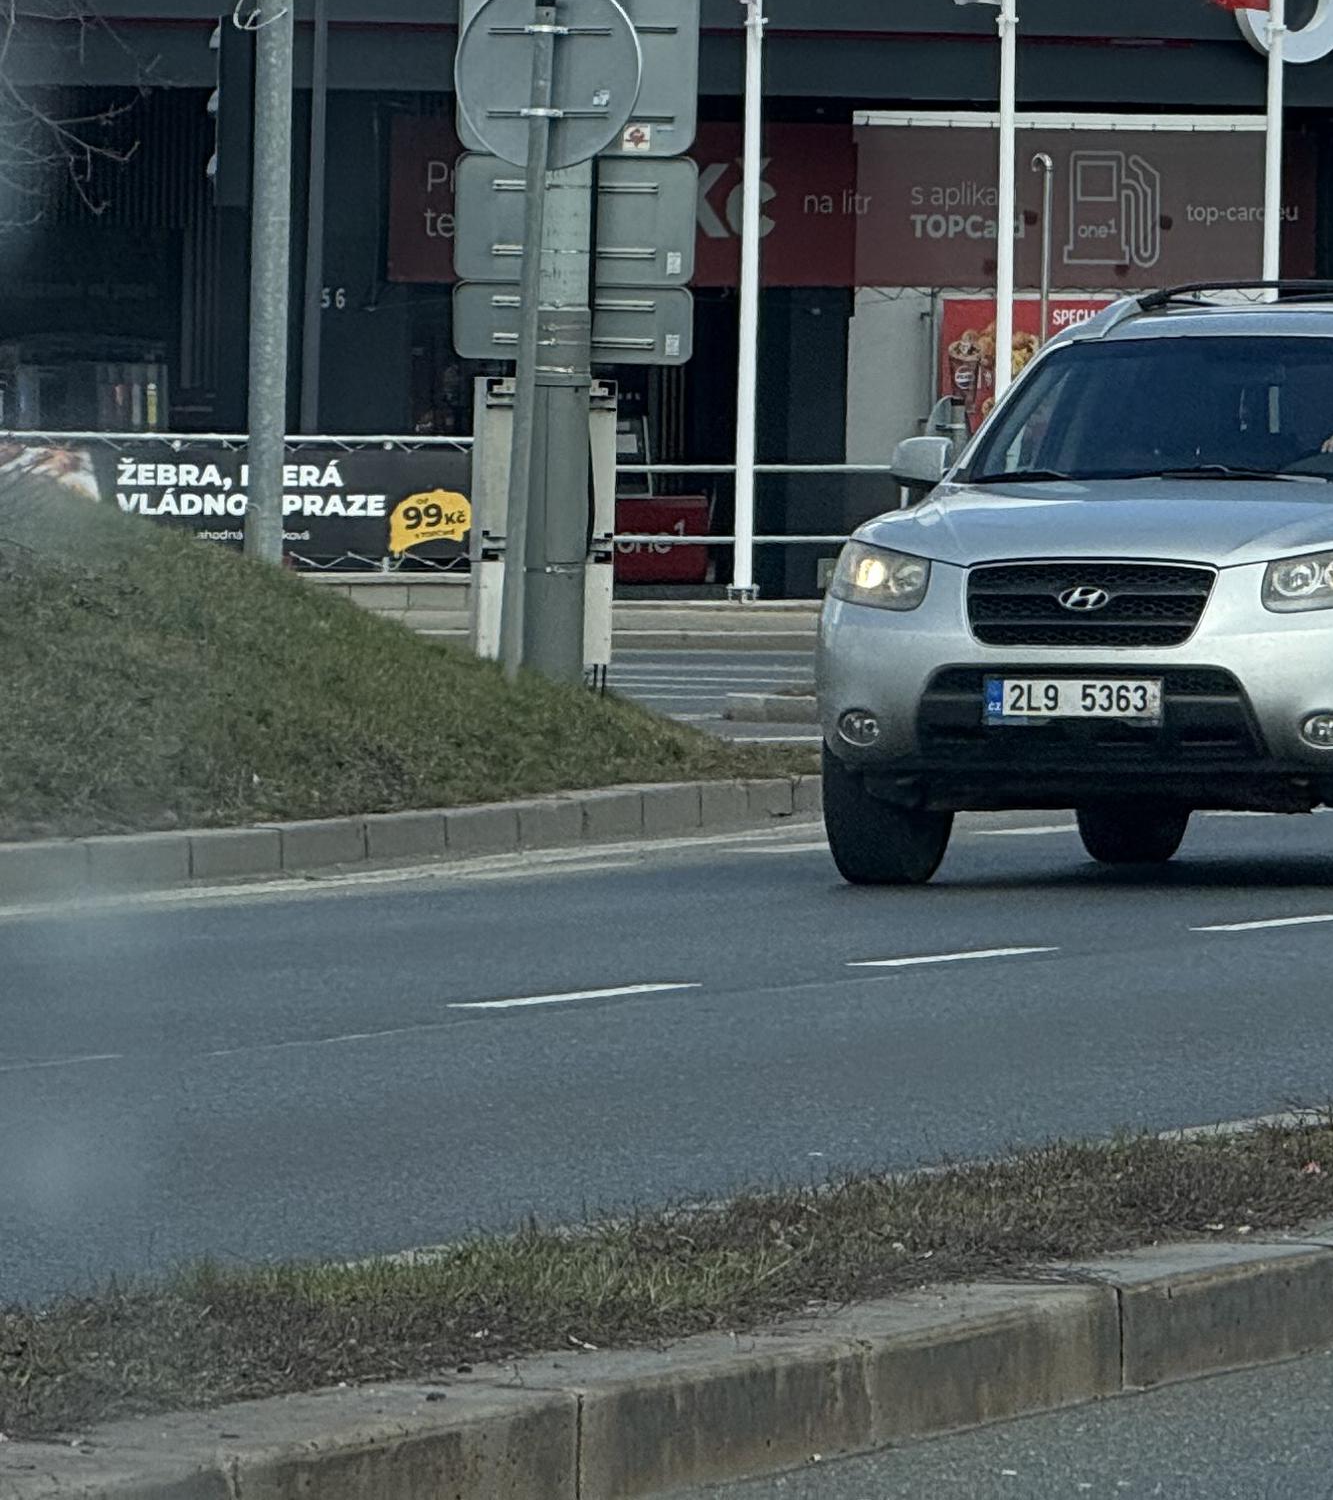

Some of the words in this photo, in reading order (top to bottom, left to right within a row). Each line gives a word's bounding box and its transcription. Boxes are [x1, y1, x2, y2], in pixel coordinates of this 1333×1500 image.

[803, 194, 833, 214] na
[842, 190, 872, 214] litr
[911, 186, 923, 206] s
[931, 180, 1016, 211] aplika
[910, 213, 1025, 239] TOPCad
[116, 457, 233, 491] ŽEBRA,
[116, 488, 249, 516] VLÁDNO
[282, 494, 386, 517] PRAZE
[402, 503, 443, 531] 99
[444, 510, 467, 526] Kč
[1009, 683, 1059, 712] 2L9
[1081, 684, 1148, 713] 5363
